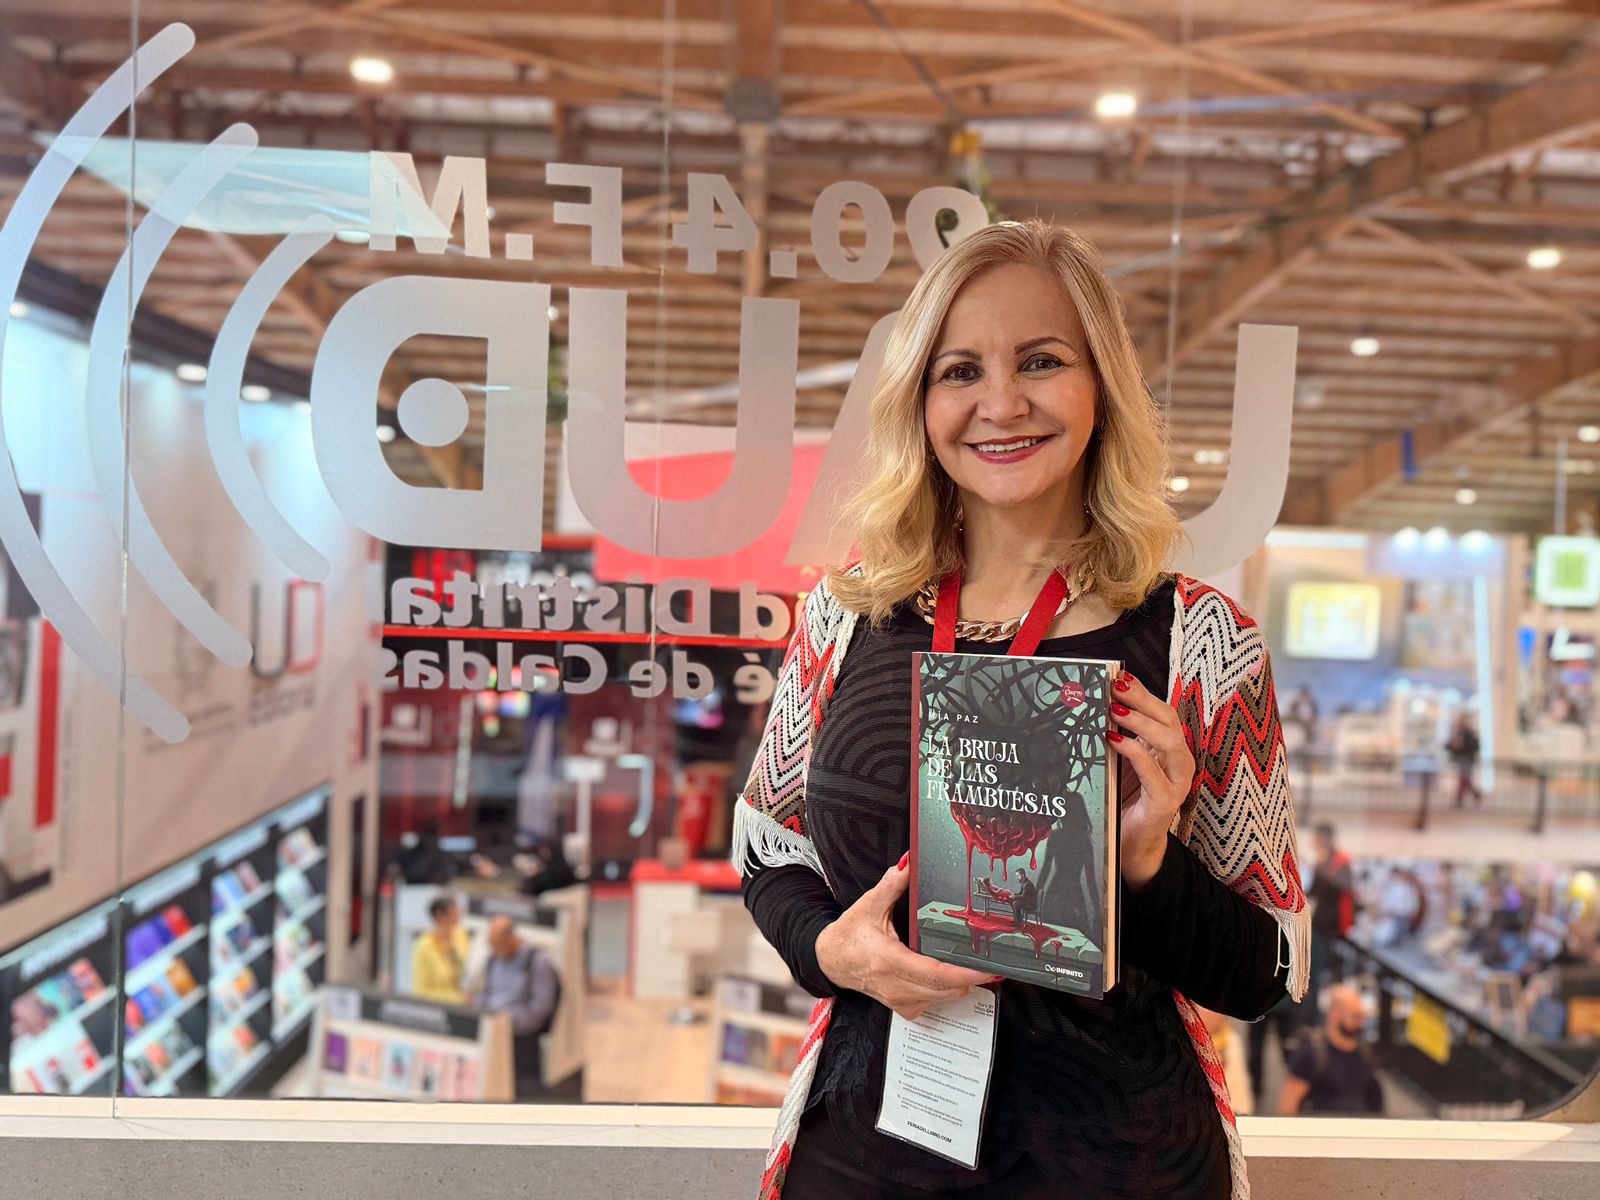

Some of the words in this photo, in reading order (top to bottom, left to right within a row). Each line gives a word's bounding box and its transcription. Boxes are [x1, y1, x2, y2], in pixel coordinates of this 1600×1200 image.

[956, 714, 979, 724] PAZ
[926, 735, 952, 756] LA
[959, 738, 1020, 764] BRUJA
[926, 757, 952, 778] DE
[960, 761, 998, 784] LAS
[926, 779, 1066, 818] FRAMBUESAS
[1056, 967, 1083, 978] INFINITO
